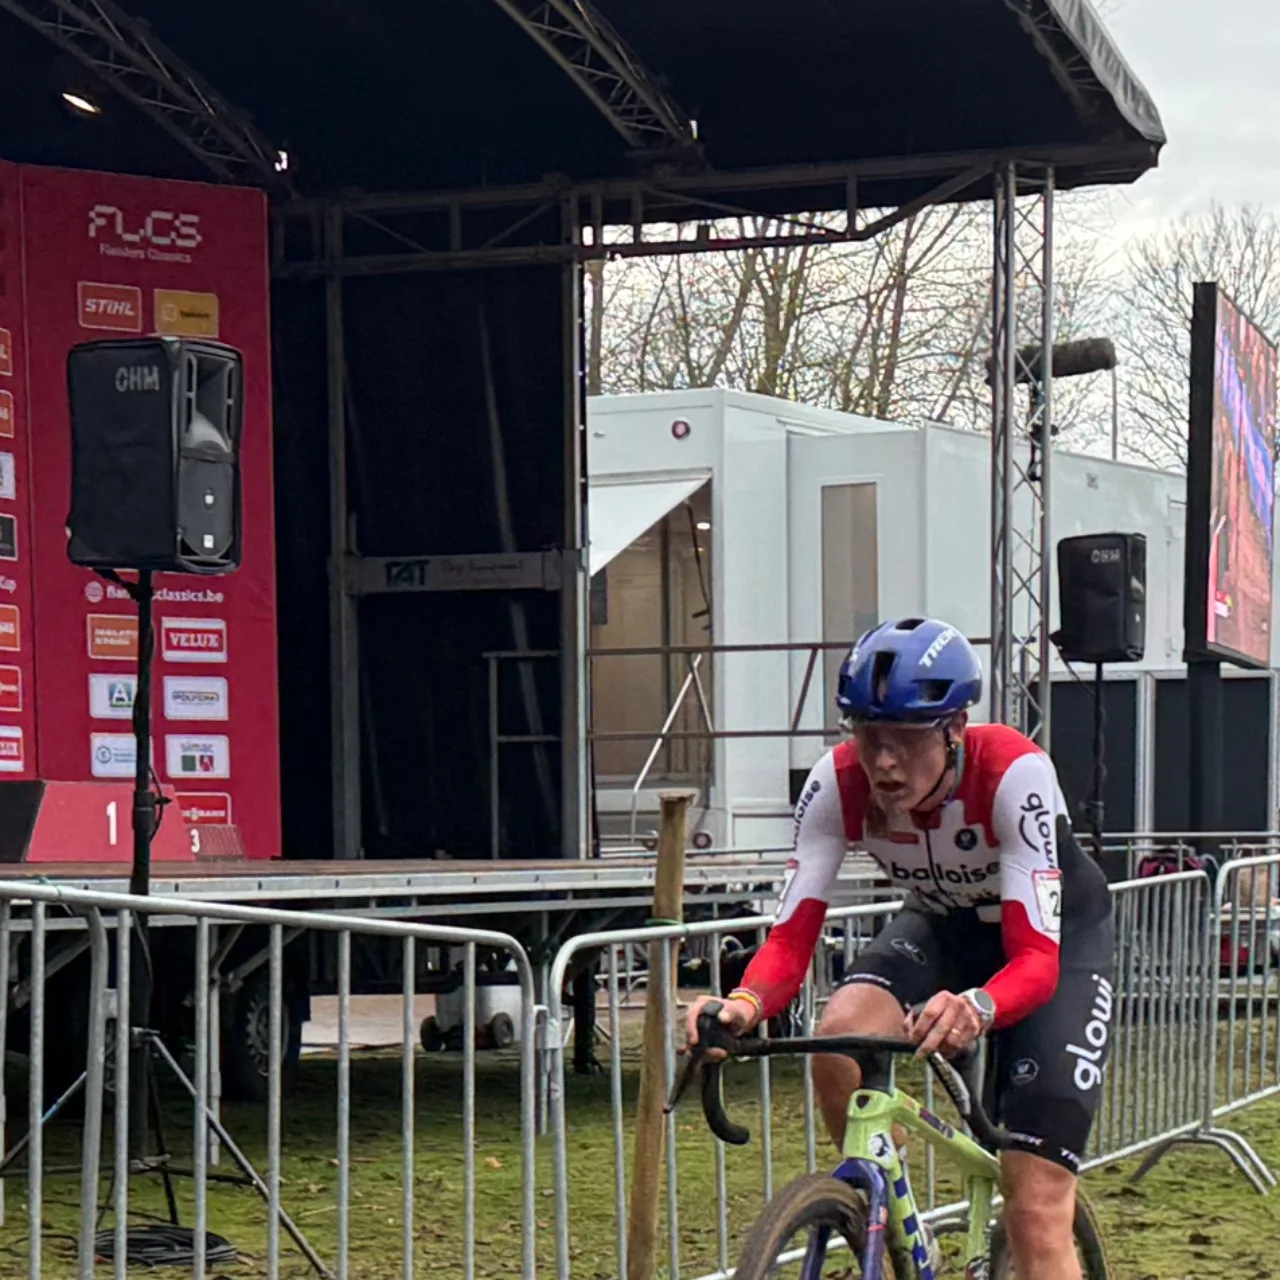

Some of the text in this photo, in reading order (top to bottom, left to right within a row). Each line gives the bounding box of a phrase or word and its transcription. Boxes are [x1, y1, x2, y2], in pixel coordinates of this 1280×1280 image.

[84, 298, 136, 317] STIHL
[169, 632, 220, 648] VELUX
[106, 801, 117, 845] 1
[191, 829, 201, 852] 3
[892, 861, 1001, 884] baloise
[1066, 974, 1113, 1090] glowi
